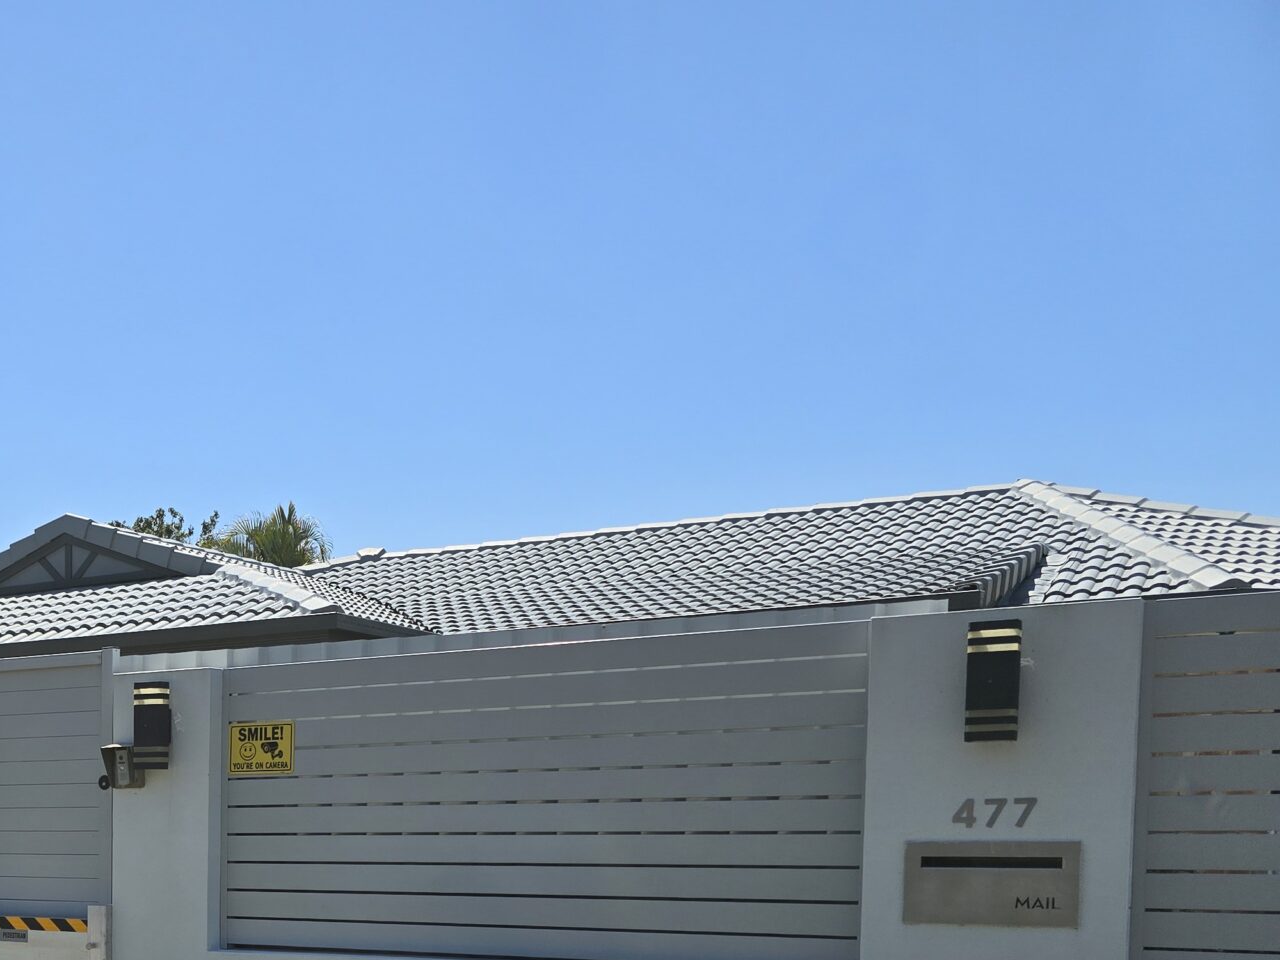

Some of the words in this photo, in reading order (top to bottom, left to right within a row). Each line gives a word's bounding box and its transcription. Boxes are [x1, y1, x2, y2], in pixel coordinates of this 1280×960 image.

[238, 726, 284, 742] SMILE!
[232, 762, 253, 770] YOU'RE
[265, 761, 289, 769] CAMERA
[951, 797, 1039, 829] 477
[1014, 896, 1062, 910] MAIL
